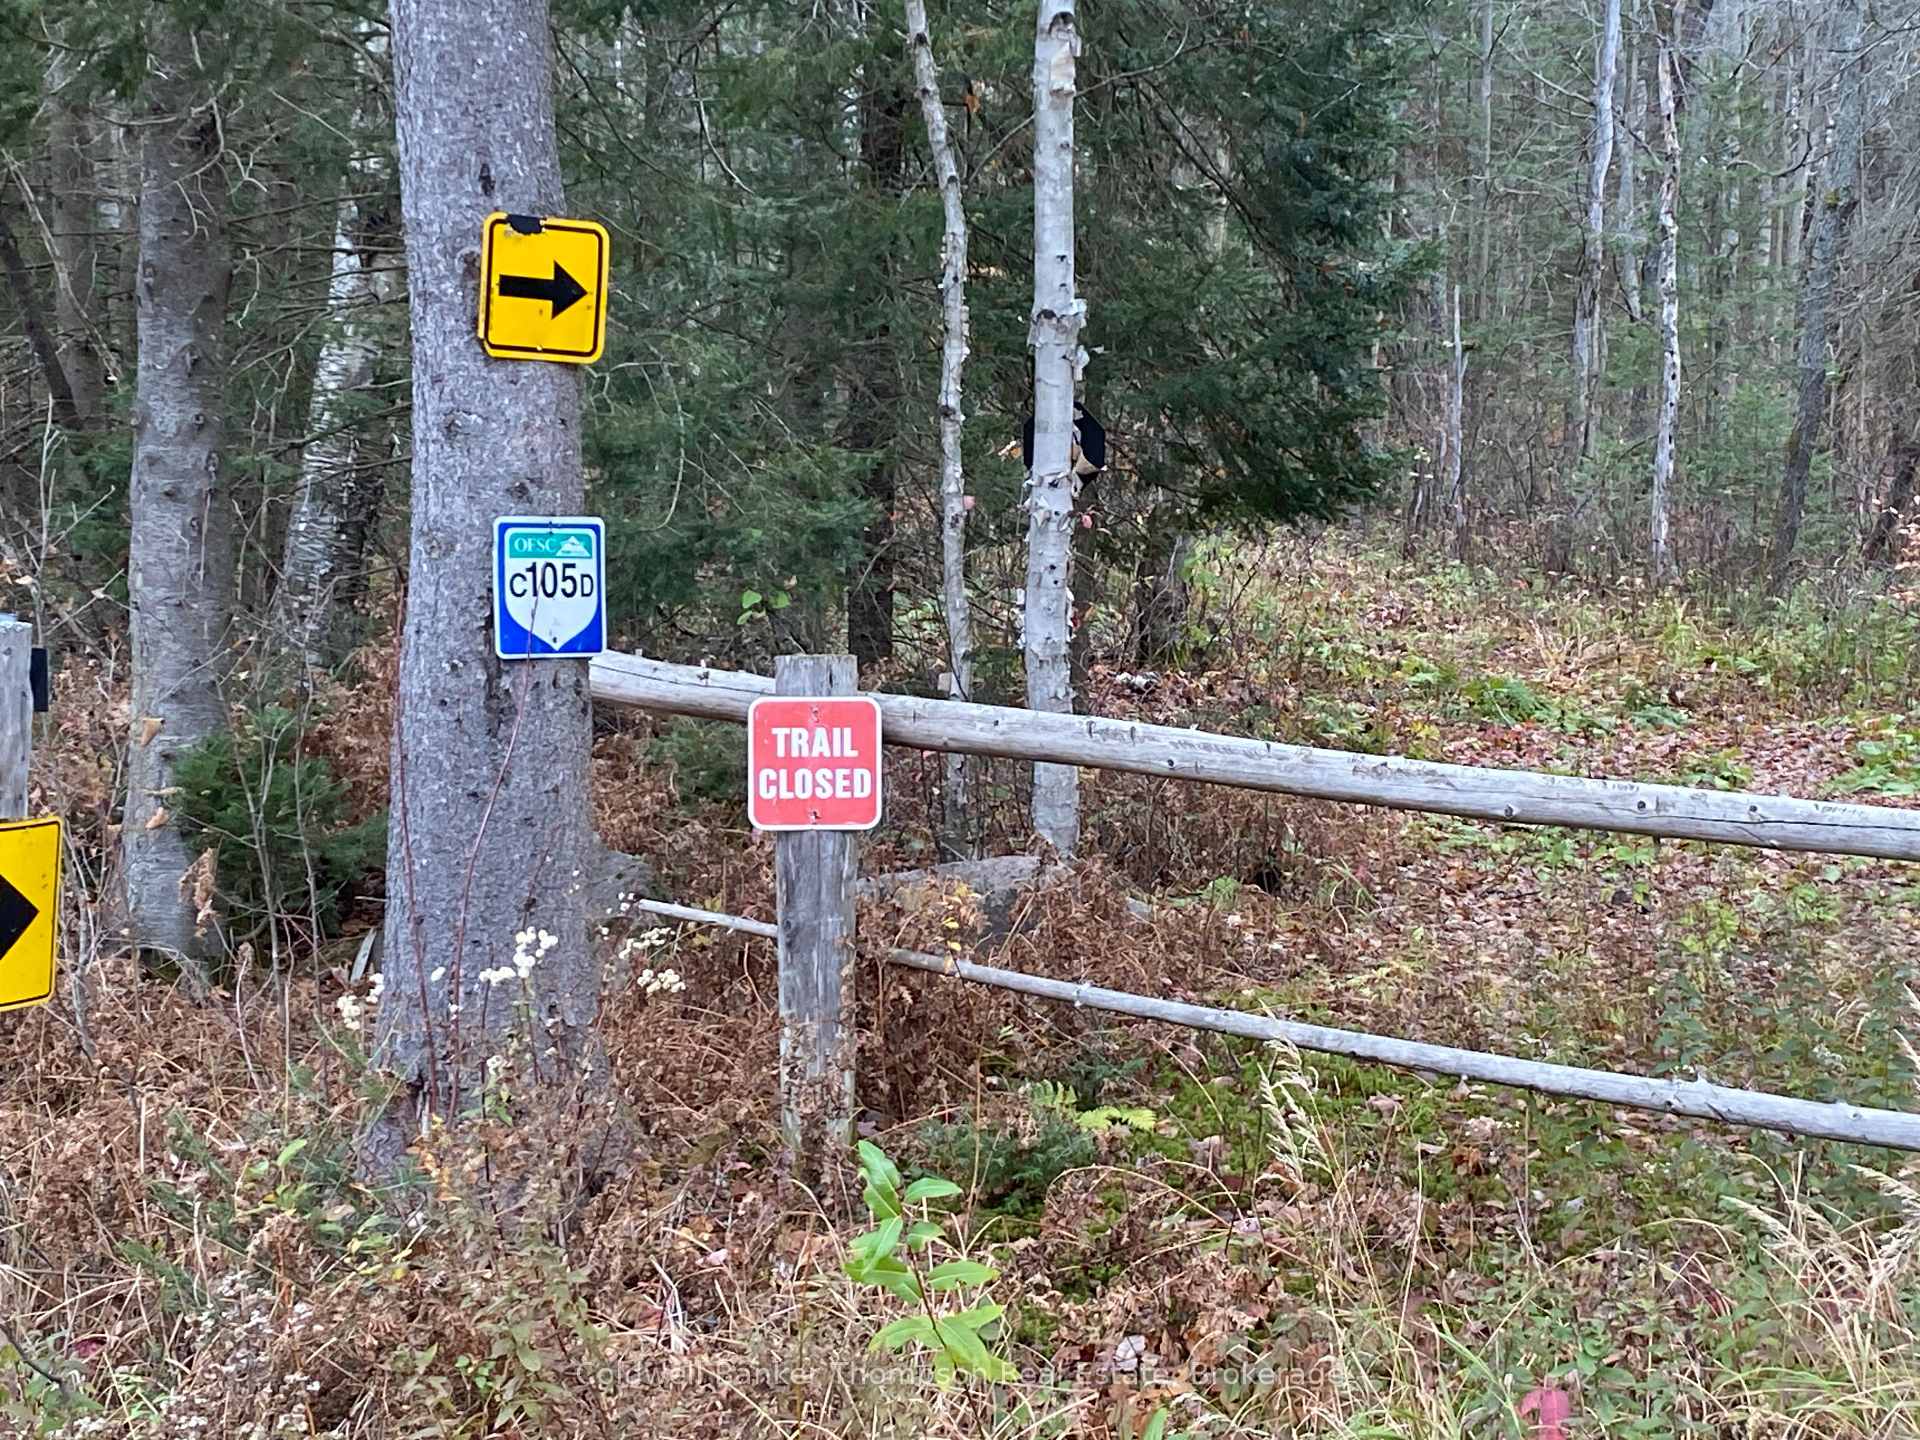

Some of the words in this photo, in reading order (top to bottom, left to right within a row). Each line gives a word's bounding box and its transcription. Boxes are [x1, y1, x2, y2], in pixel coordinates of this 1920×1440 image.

[514, 537, 556, 553] OFSC
[771, 727, 859, 758] TRAIL
[758, 767, 872, 800] CLOSED
